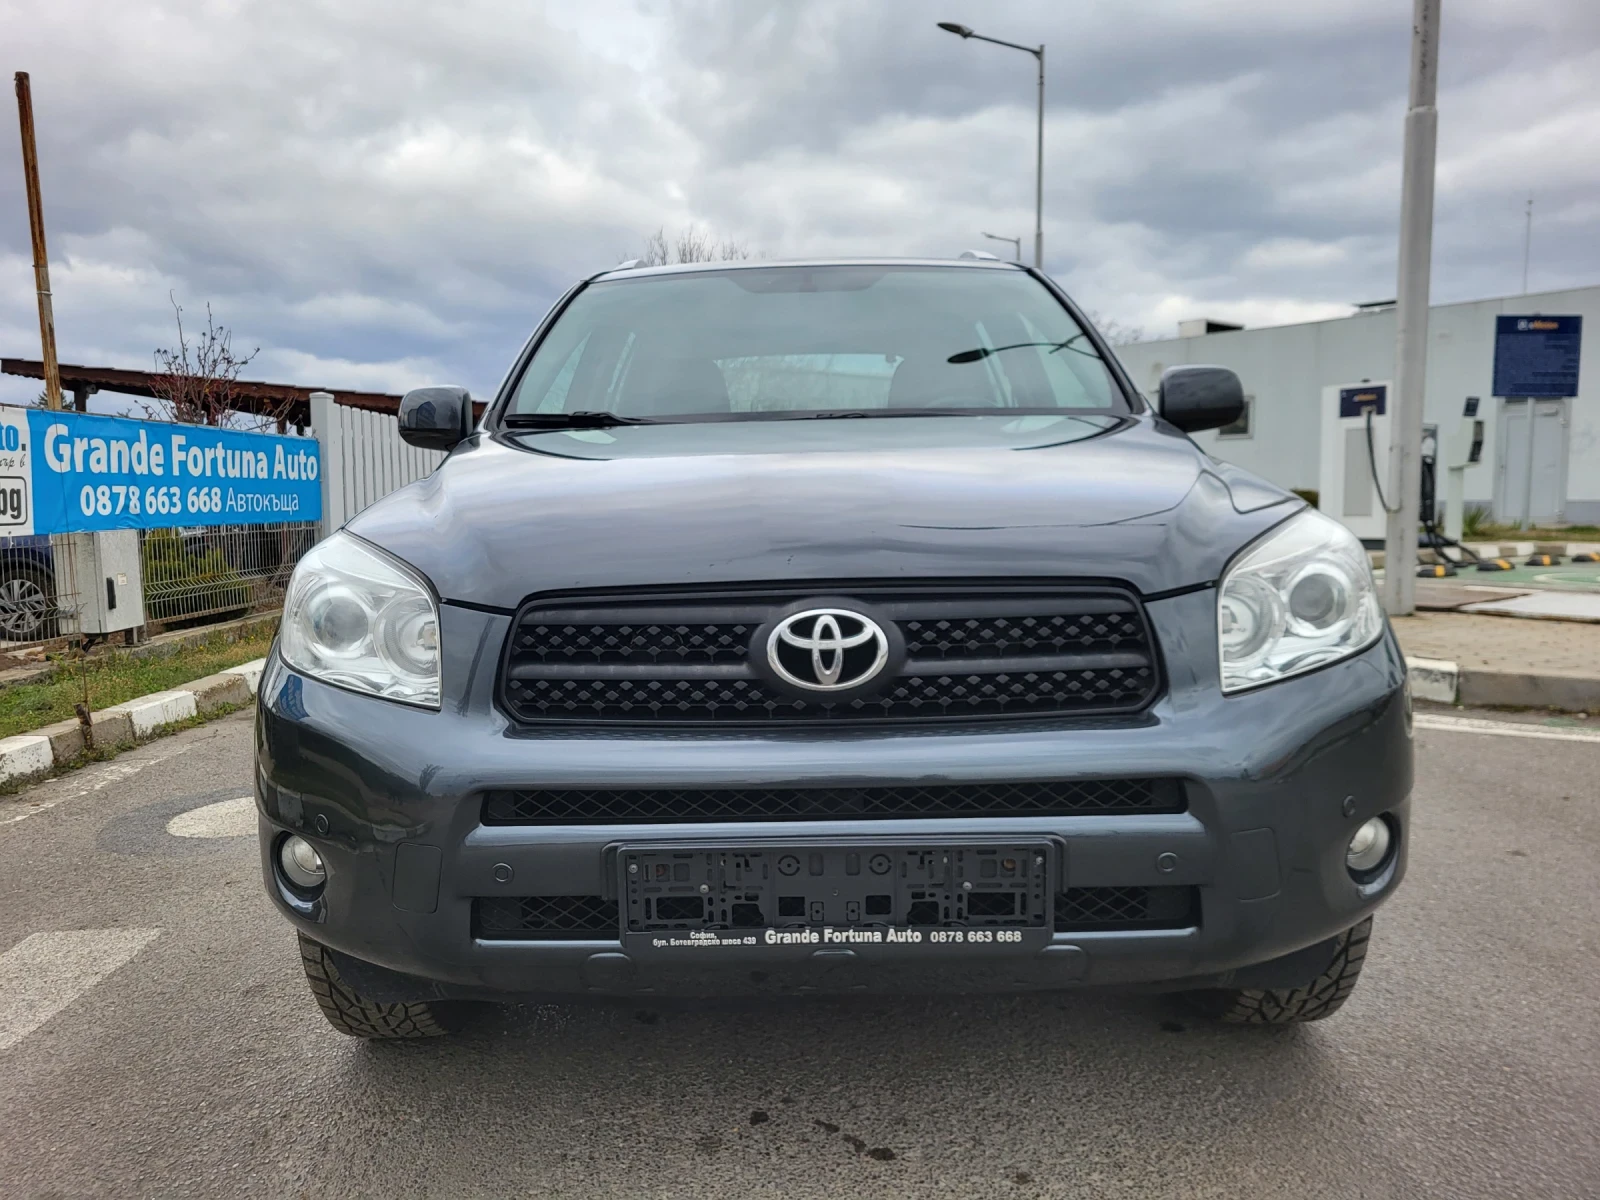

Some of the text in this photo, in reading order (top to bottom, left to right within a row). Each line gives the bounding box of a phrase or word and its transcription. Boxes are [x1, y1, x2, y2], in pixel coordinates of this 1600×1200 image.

[44, 424, 318, 481] Grande Fortuna Auto
[80, 485, 299, 516] 0878 663 668 Автокъща
[653, 938, 669, 947] бул.
[690, 931, 717, 939] София,
[765, 928, 1022, 944] Grande Fortuna Auto 0878 663 668
